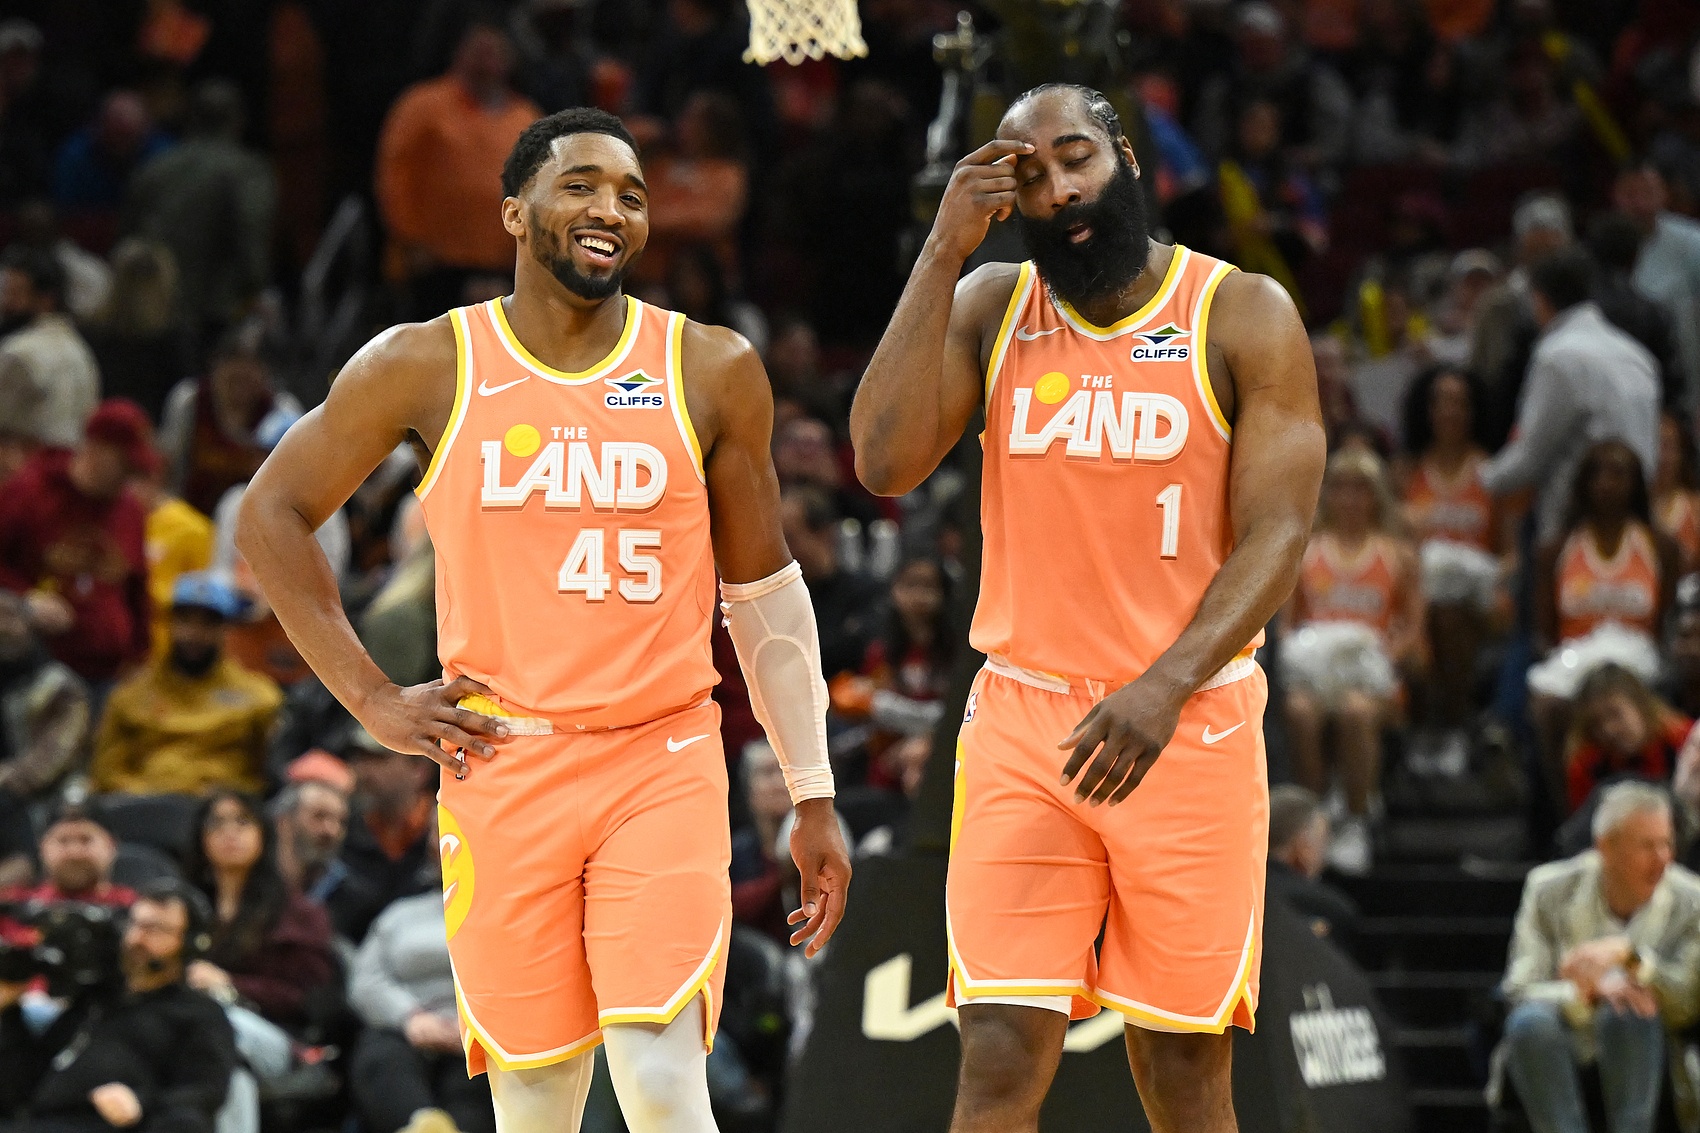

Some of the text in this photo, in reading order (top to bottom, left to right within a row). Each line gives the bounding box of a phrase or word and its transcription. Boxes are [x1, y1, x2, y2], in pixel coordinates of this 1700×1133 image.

[1132, 348, 1189, 359] CLIFFS
[606, 396, 663, 406] CLIFFS
[1080, 374, 1113, 388] THE
[550, 426, 588, 440] THE
[1008, 388, 1190, 465] LAND
[480, 440, 668, 512] LAND
[1156, 483, 1183, 561] 1
[557, 528, 663, 604] 45
